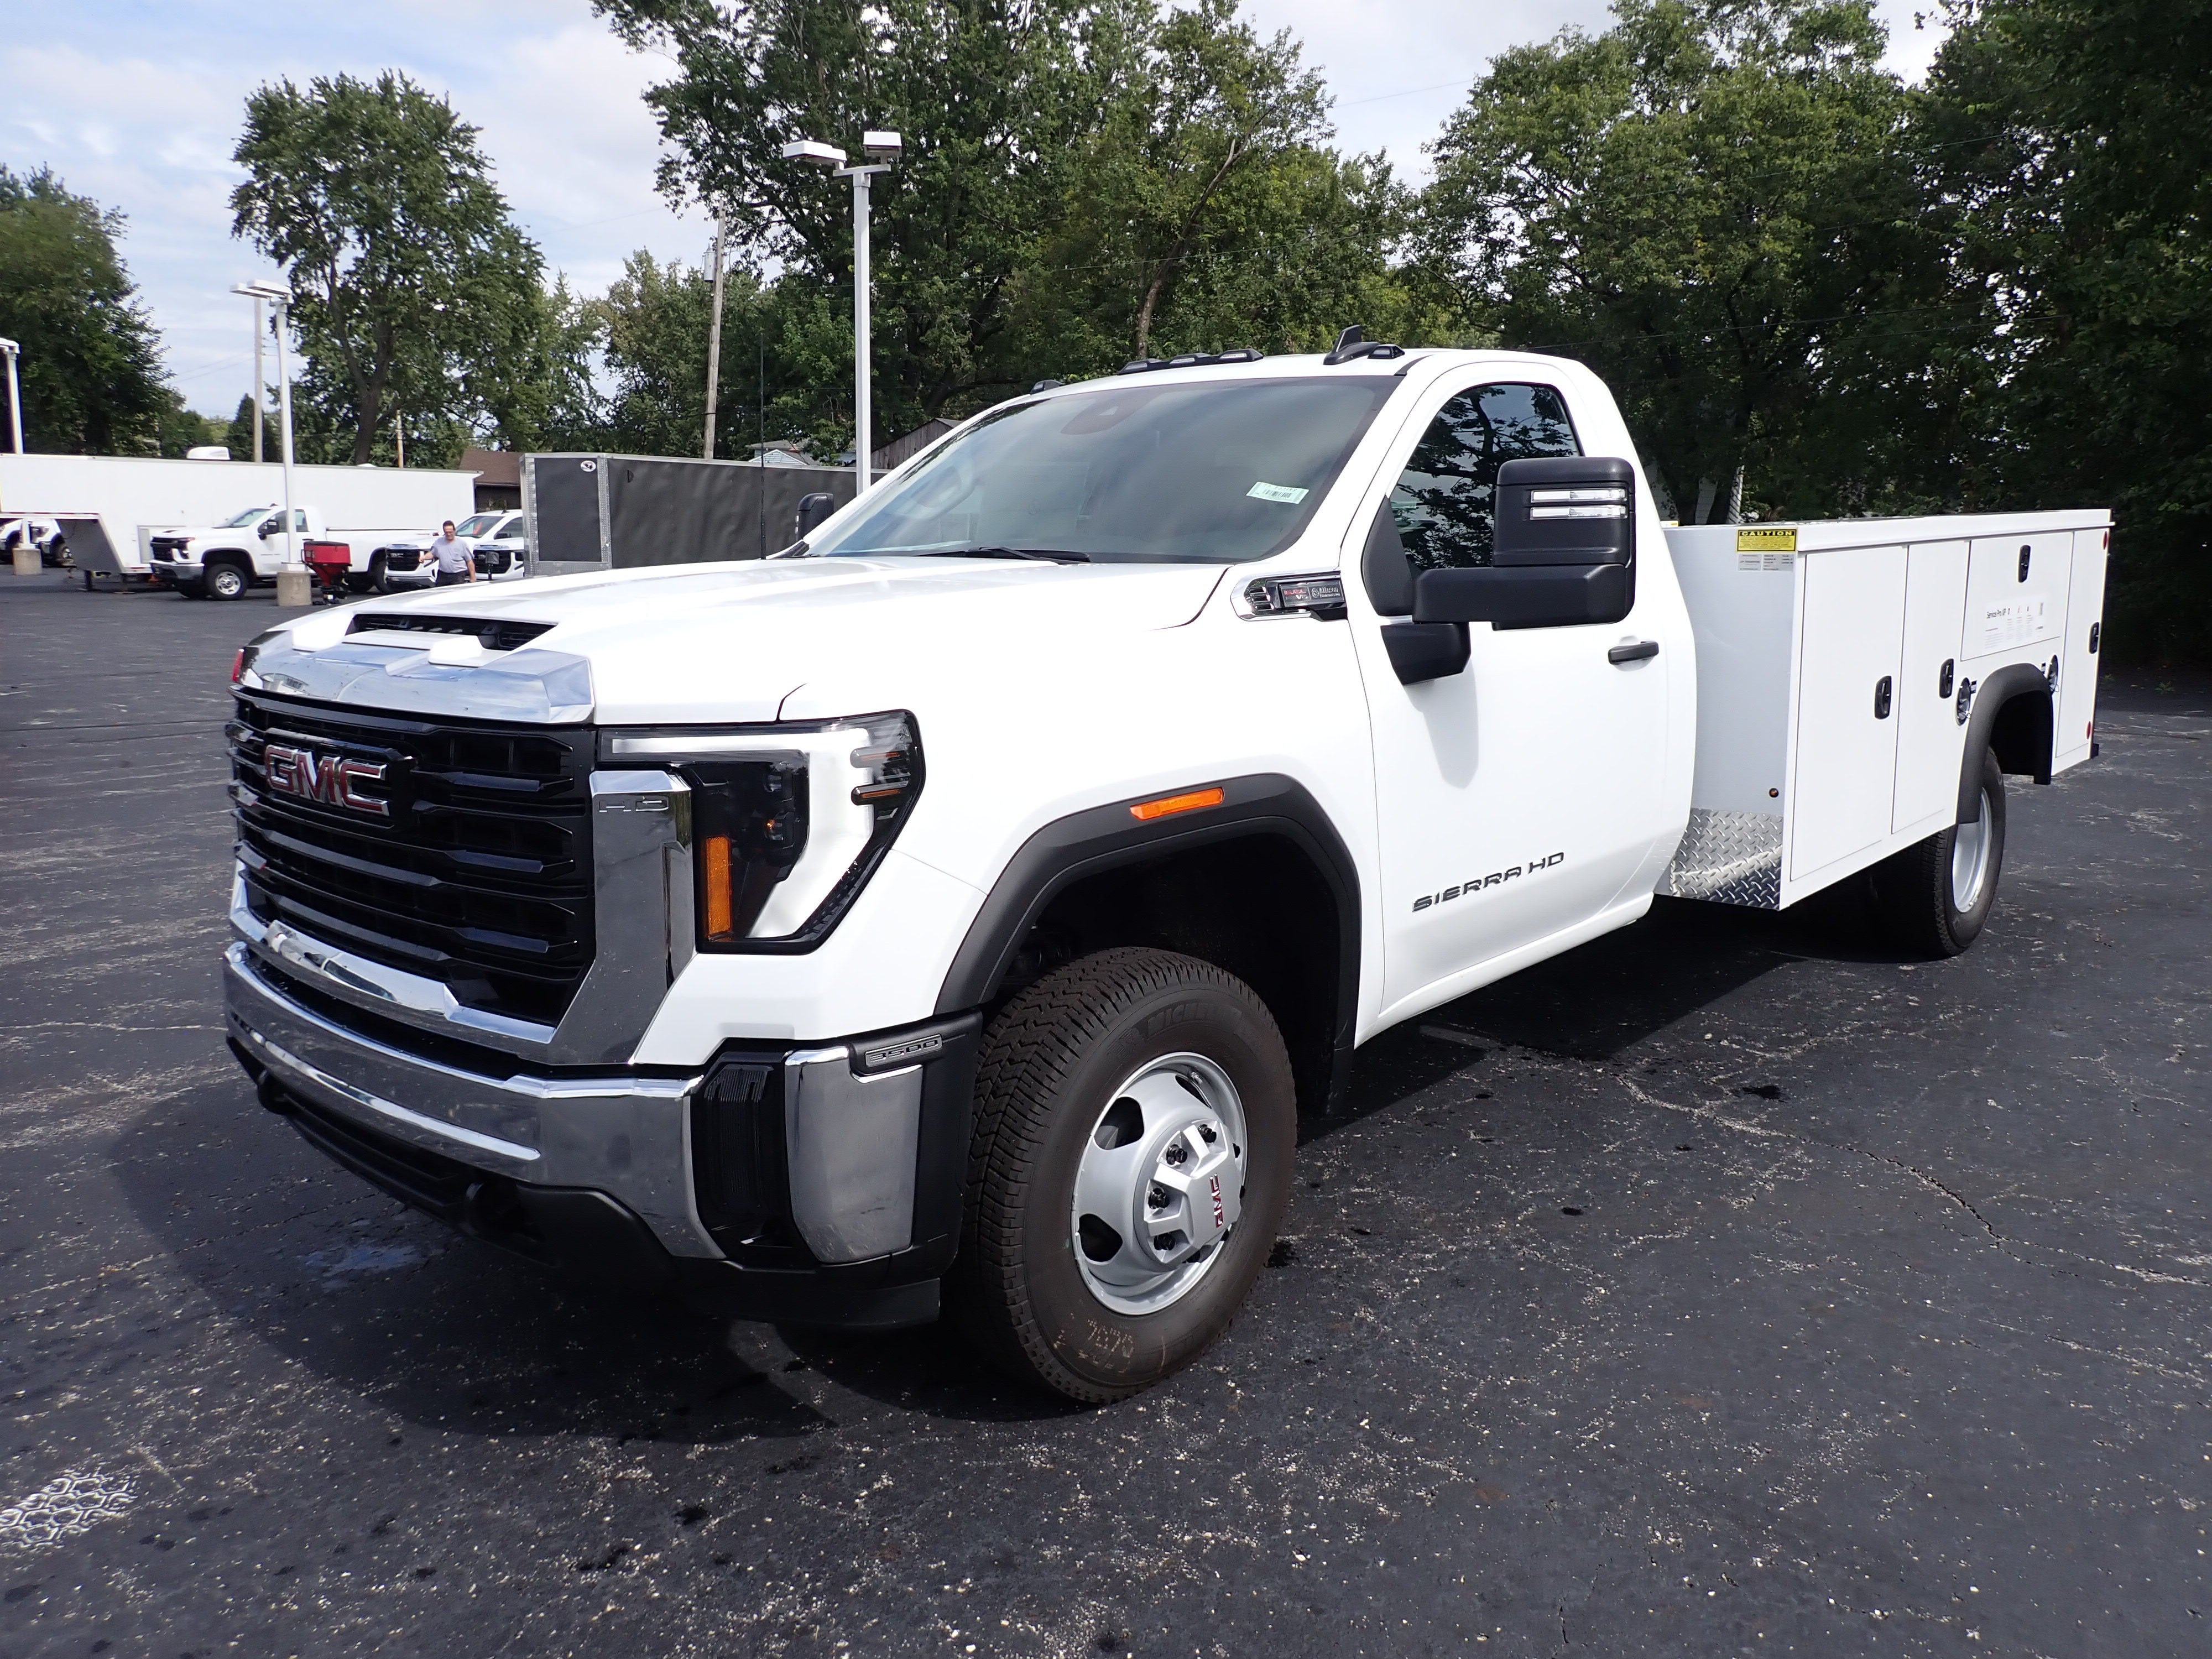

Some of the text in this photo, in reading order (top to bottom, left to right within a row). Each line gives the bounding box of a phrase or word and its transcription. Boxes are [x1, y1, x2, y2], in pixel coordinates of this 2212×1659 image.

[265, 744, 390, 816] GMC
[599, 799, 669, 812] HD
[1412, 852, 1564, 912] SIERRA HD
[870, 1039, 938, 1062] 3500
[1209, 1173, 1224, 1228] GMC
